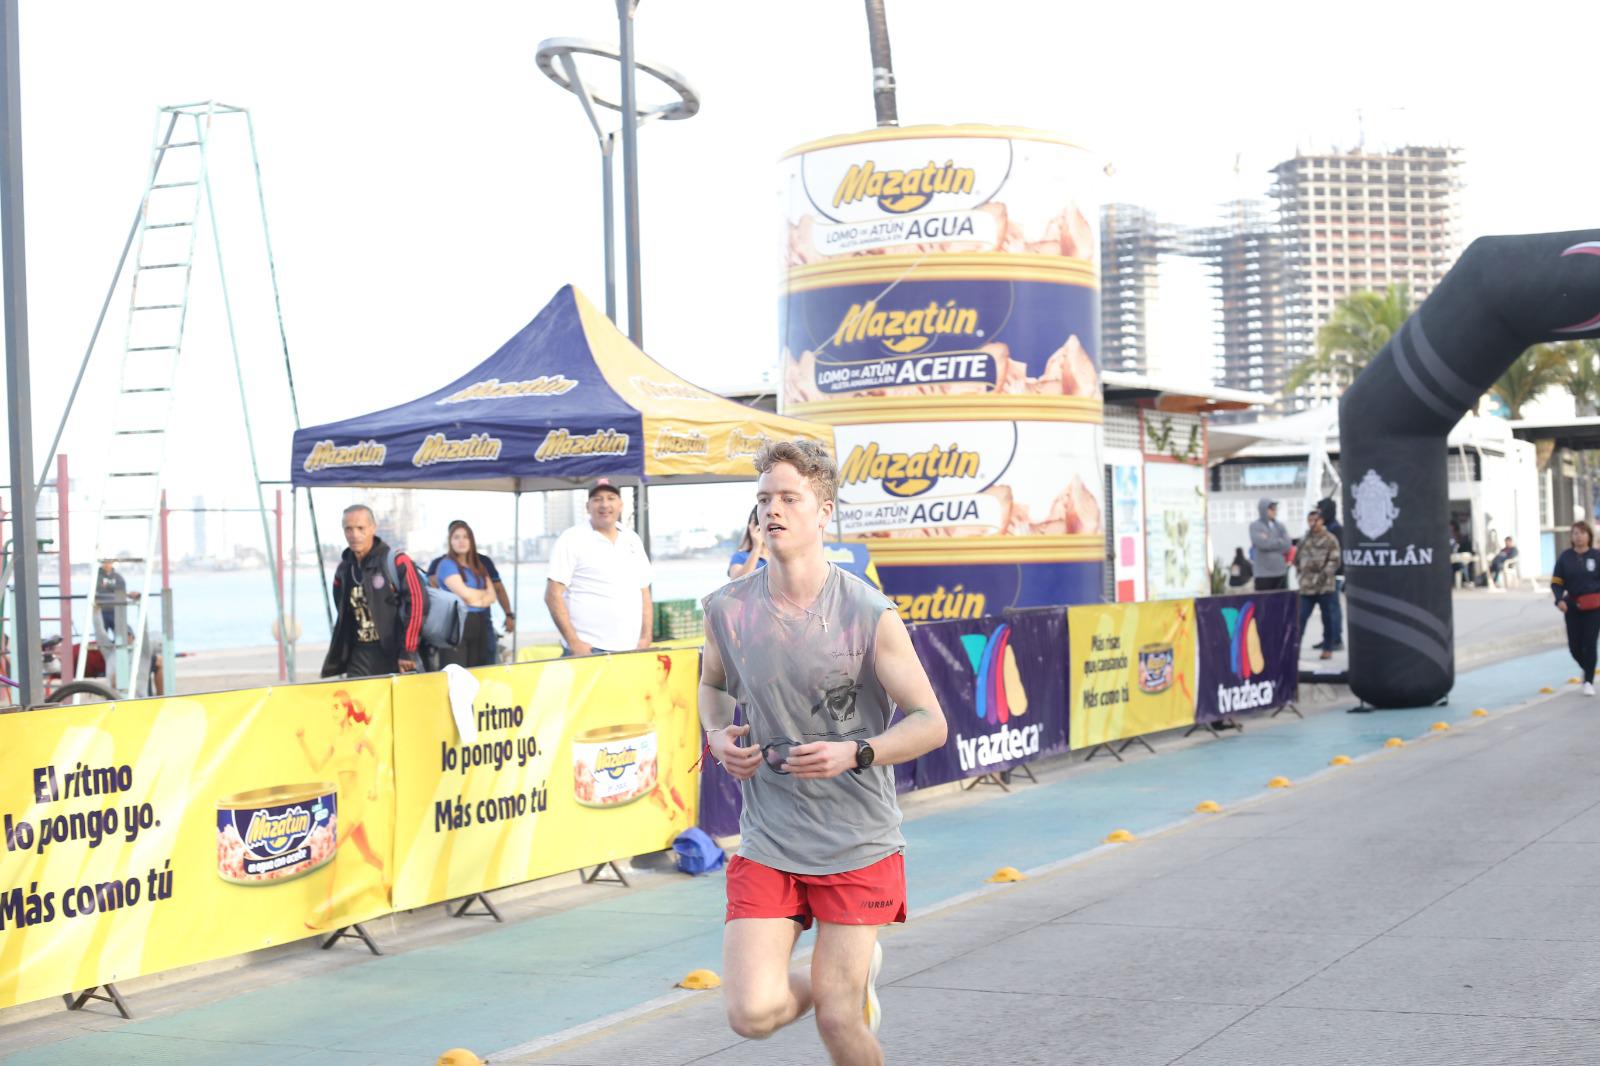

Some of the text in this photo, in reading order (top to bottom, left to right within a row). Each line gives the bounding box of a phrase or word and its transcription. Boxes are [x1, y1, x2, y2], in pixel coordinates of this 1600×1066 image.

[832, 159, 975, 208] Mazatún
[826, 228, 858, 244] LOMO
[869, 220, 905, 236] ATÚN
[905, 216, 974, 240] AGUA
[833, 300, 977, 346] Mazatún
[818, 368, 850, 385] LOMO
[860, 360, 897, 378] ATÚN
[896, 354, 988, 383] ACEITE
[303, 439, 387, 473] Mazatún
[412, 432, 502, 467] Mazatún
[534, 427, 629, 463] Mazatún
[838, 441, 980, 488] Mazatún
[874, 503, 909, 518] ATÚN
[910, 500, 979, 524] AGUA
[1343, 543, 1433, 566] AZATLÁN
[888, 585, 985, 620] zatún
[478, 702, 523, 732] ritmo
[441, 736, 541, 775] lo pongo yo.
[33, 762, 133, 804] El ritmo
[435, 780, 547, 832] Más como tú
[4, 802, 161, 854] lo pongo yo.
[246, 807, 310, 848] Mazatún
[0, 859, 173, 931] Más como tú
